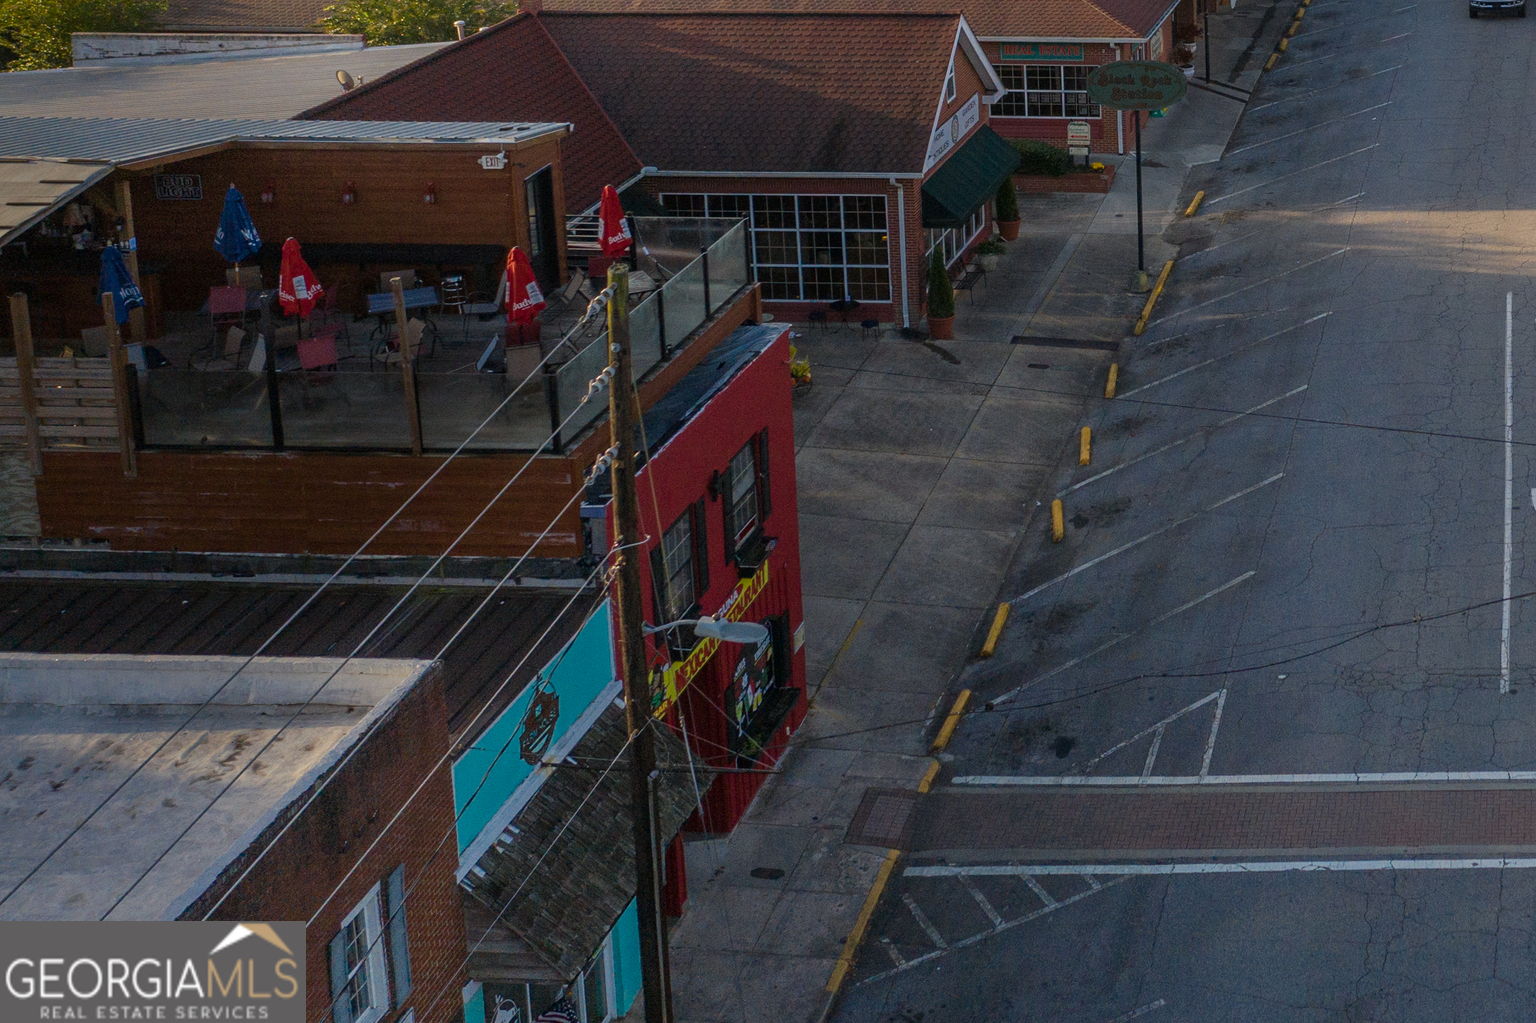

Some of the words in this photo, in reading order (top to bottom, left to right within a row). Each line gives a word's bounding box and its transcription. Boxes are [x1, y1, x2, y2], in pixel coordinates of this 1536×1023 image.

[1003, 44, 1035, 56] REAL
[1038, 44, 1081, 56] ESTATE
[1097, 73, 1136, 87] Black
[1139, 74, 1173, 88] Rock
[1110, 86, 1164, 102] Station
[485, 156, 501, 168] EXIT
[162, 176, 193, 187] BUD
[160, 186, 200, 197] LIGHT
[652, 699, 669, 719] BAR
